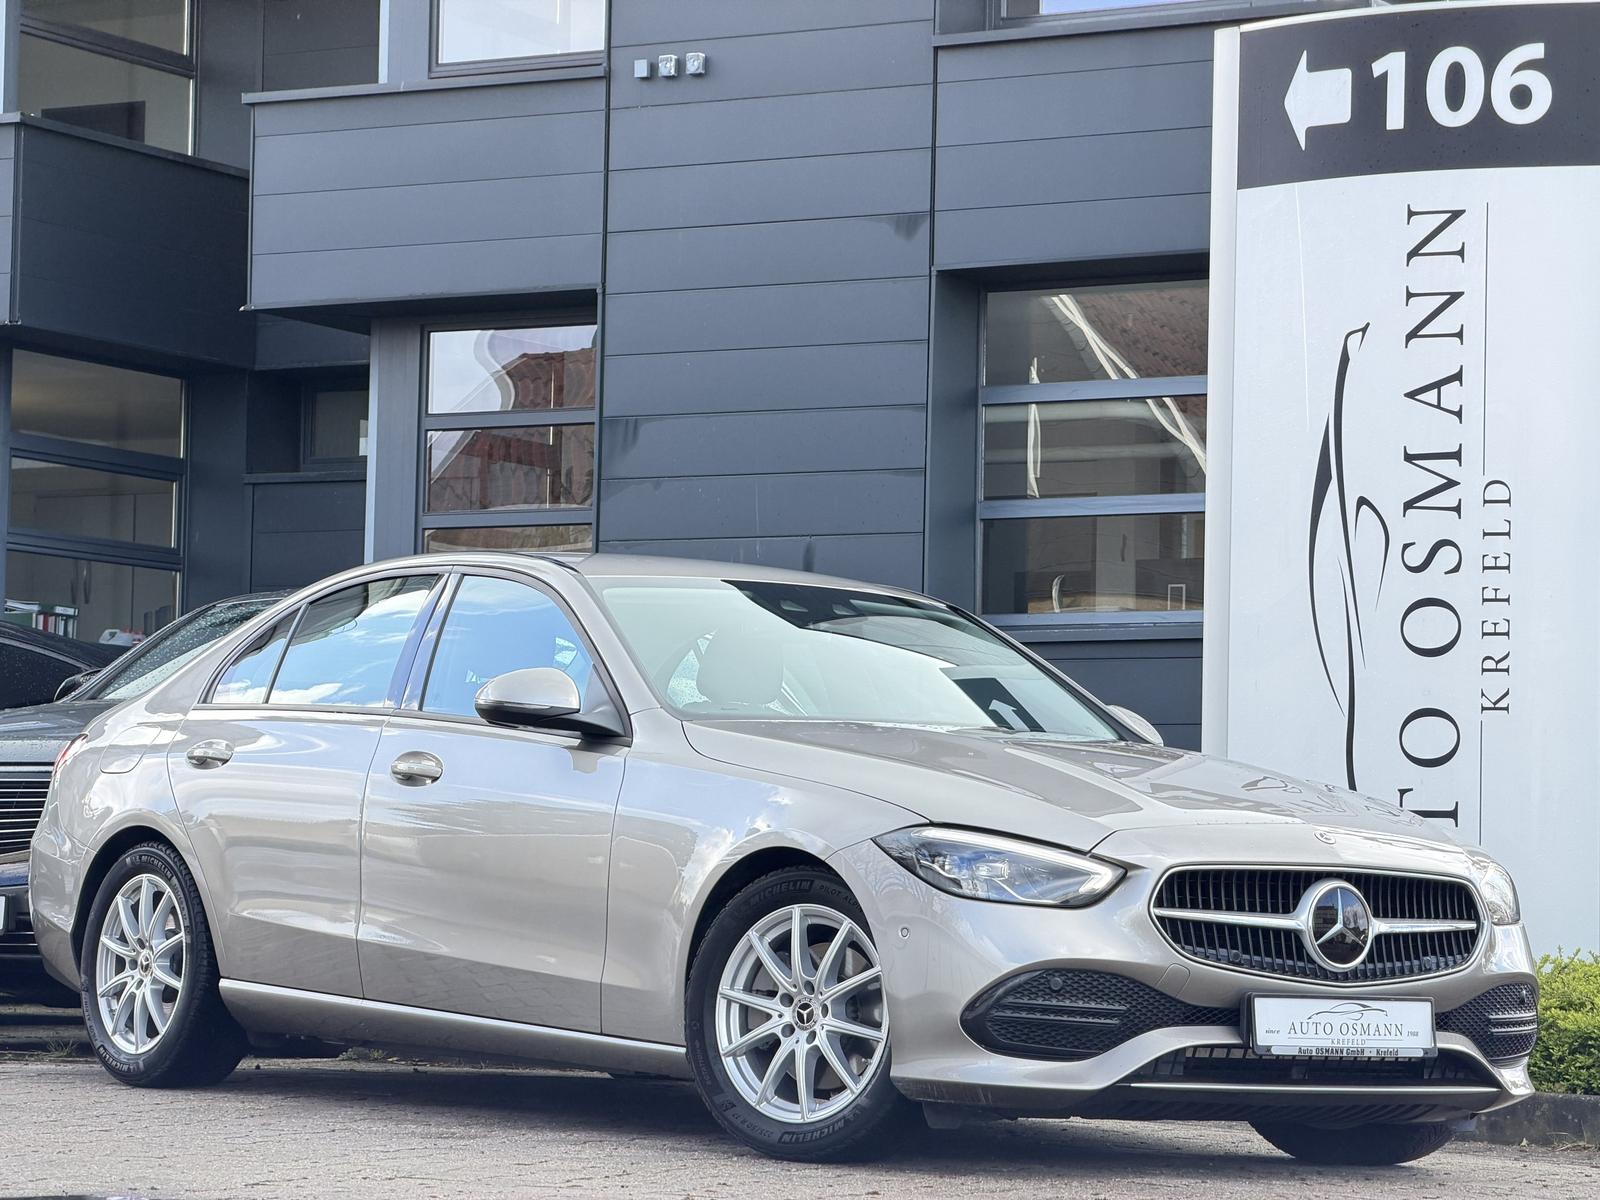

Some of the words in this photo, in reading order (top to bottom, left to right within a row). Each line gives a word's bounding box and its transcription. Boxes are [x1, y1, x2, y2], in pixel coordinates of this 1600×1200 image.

[1371, 42, 1552, 130] 106
[1400, 204, 1466, 658] OSMANN
[1480, 479, 1512, 715] KREFELD
[141, 855, 173, 879] MICHELIN
[750, 880, 811, 905] MICHELIN
[1288, 1021, 1334, 1036] AUTO
[1339, 1022, 1403, 1037] OSMANN
[1298, 1047, 1313, 1055] Auto
[1315, 1047, 1344, 1056] OSMANN
[1345, 1048, 1365, 1056] GmbH
[1331, 1038, 1366, 1046] KREFELD
[99, 1047, 128, 1072] MICHELIN
[780, 1119, 846, 1143] MICHELIN
